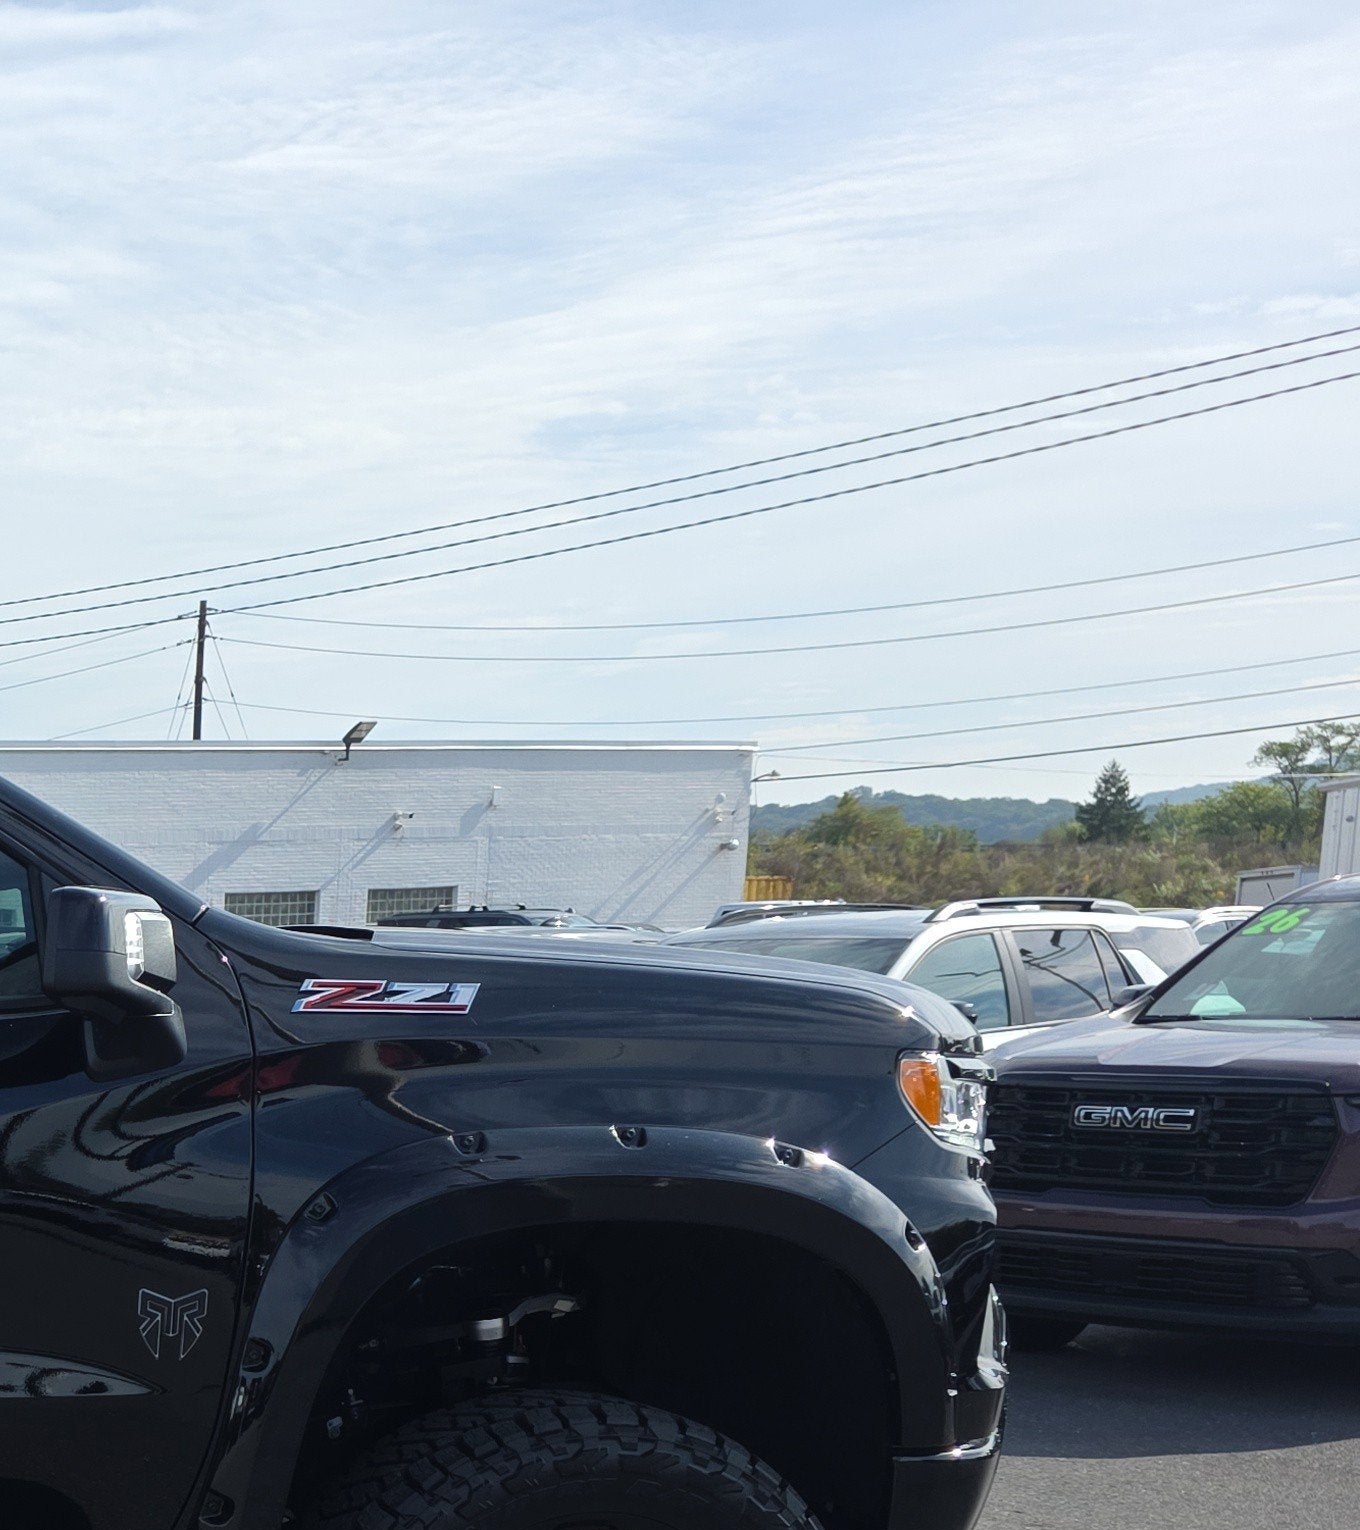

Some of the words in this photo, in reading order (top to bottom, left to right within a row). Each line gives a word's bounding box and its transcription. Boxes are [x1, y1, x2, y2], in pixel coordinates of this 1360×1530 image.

[1240, 907, 1311, 936] 26
[290, 978, 481, 1015] Z71
[1074, 1105, 1195, 1130] GMC
